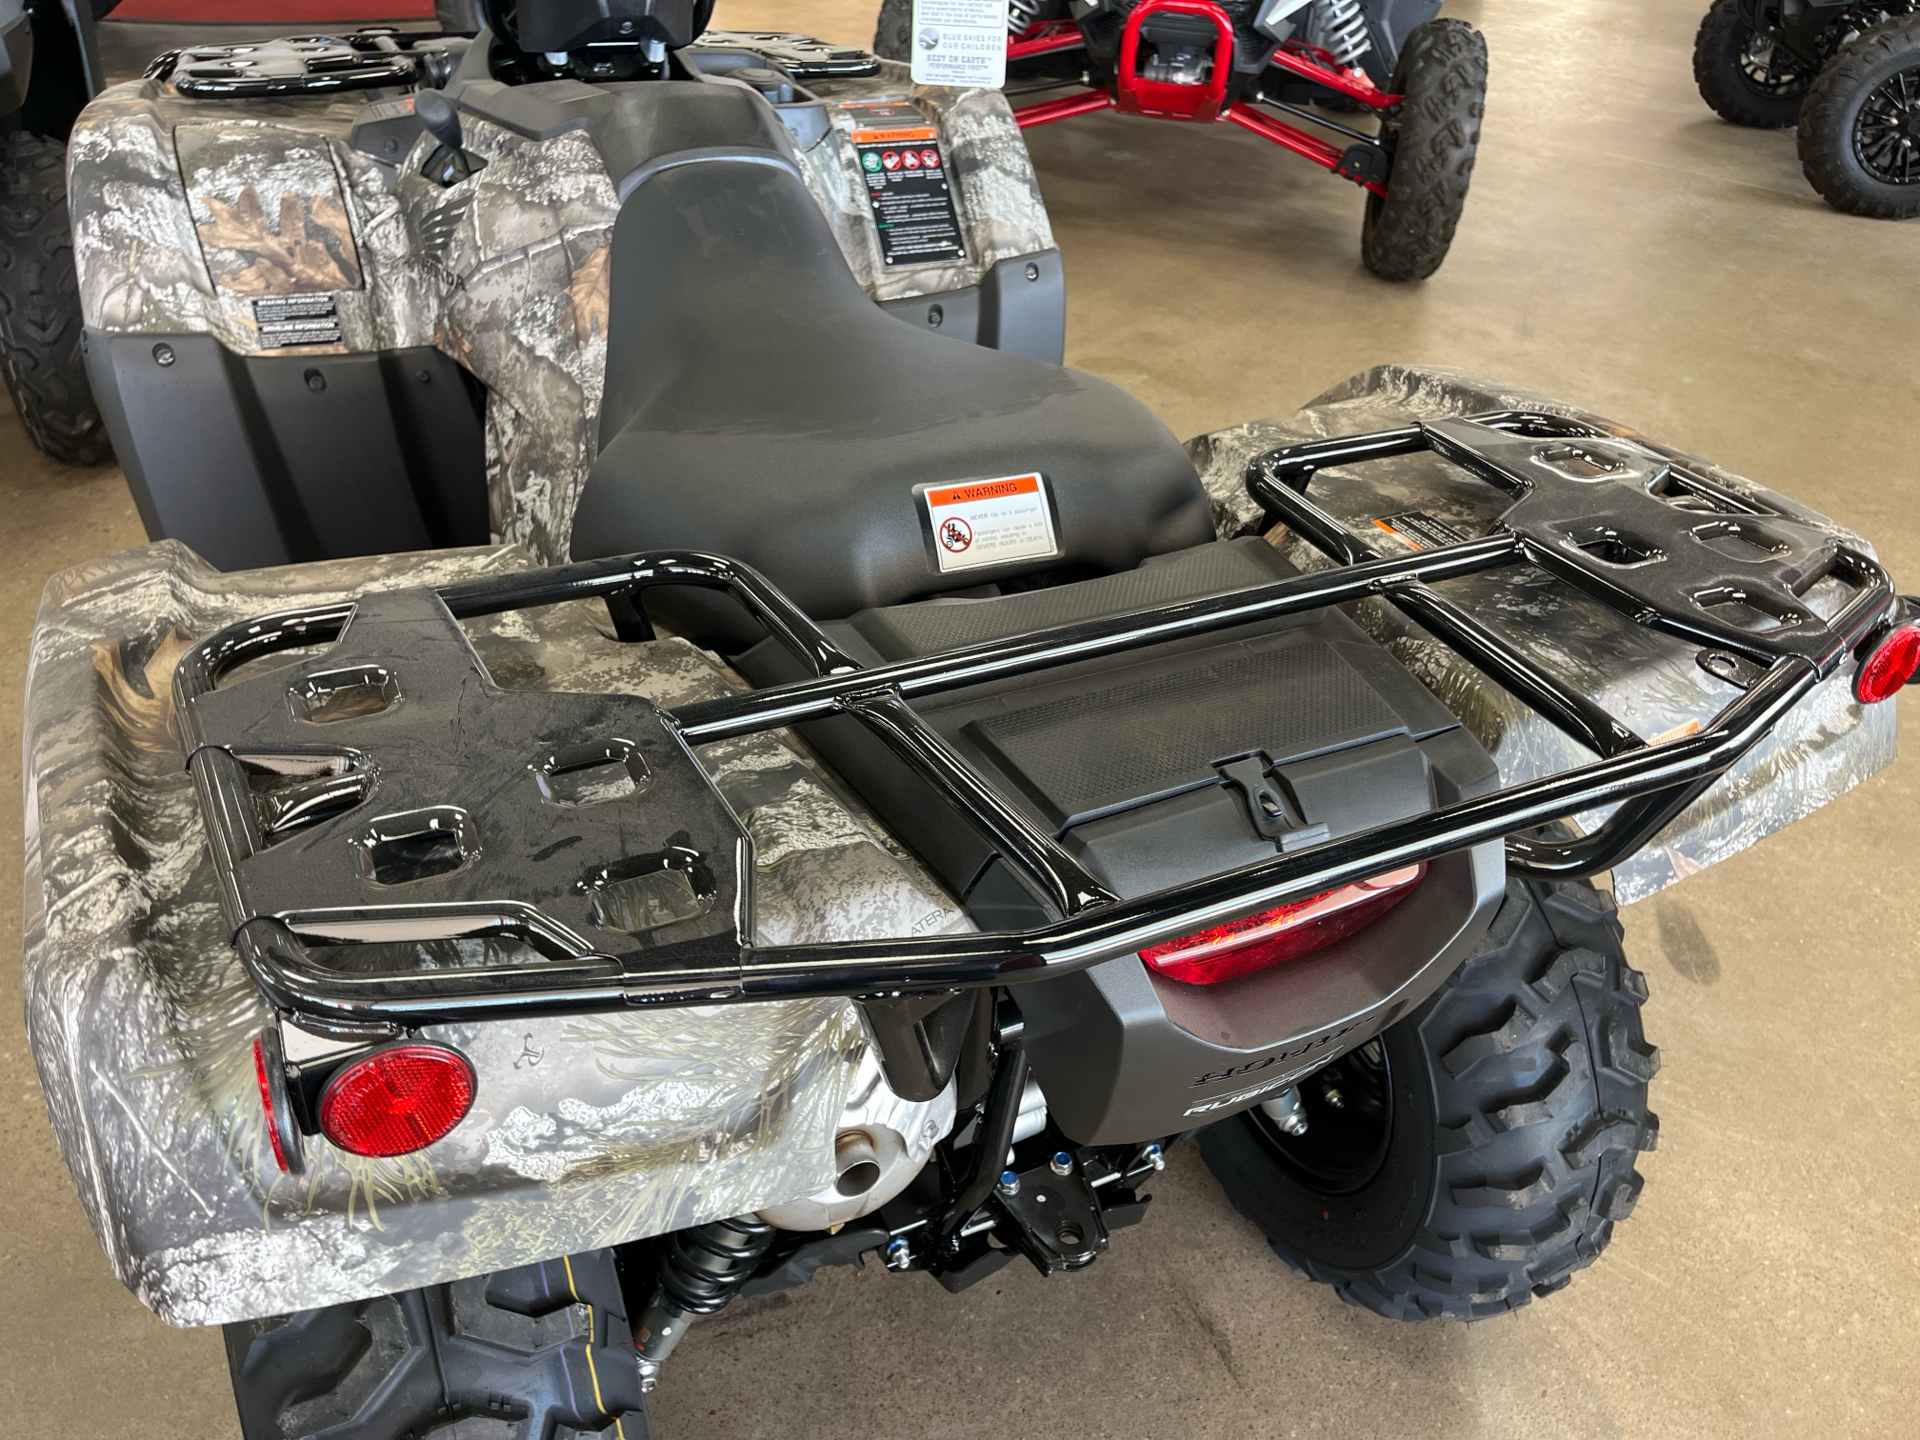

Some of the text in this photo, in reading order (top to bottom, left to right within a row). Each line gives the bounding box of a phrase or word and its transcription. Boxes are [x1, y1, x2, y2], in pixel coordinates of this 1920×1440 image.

[963, 34, 986, 42] SKIES
[987, 35, 1003, 43] FOR
[942, 42, 1003, 51] OUR CHILDREN
[926, 54, 947, 62] BEST
[928, 62, 966, 70] PERFORMANCE
[878, 131, 915, 140] WARNING
[258, 296, 329, 307] BRAKING INFORMATION
[294, 322, 335, 330] INFORMATION
[965, 482, 1017, 498] WARNING
[970, 513, 988, 521] NEVER
[973, 528, 1000, 537] Passengers
[1000, 531, 1020, 539] resulting
[975, 542, 997, 550] SEVERE
[999, 538, 1017, 547] INJURY
[911, 908, 955, 937] ATERA
